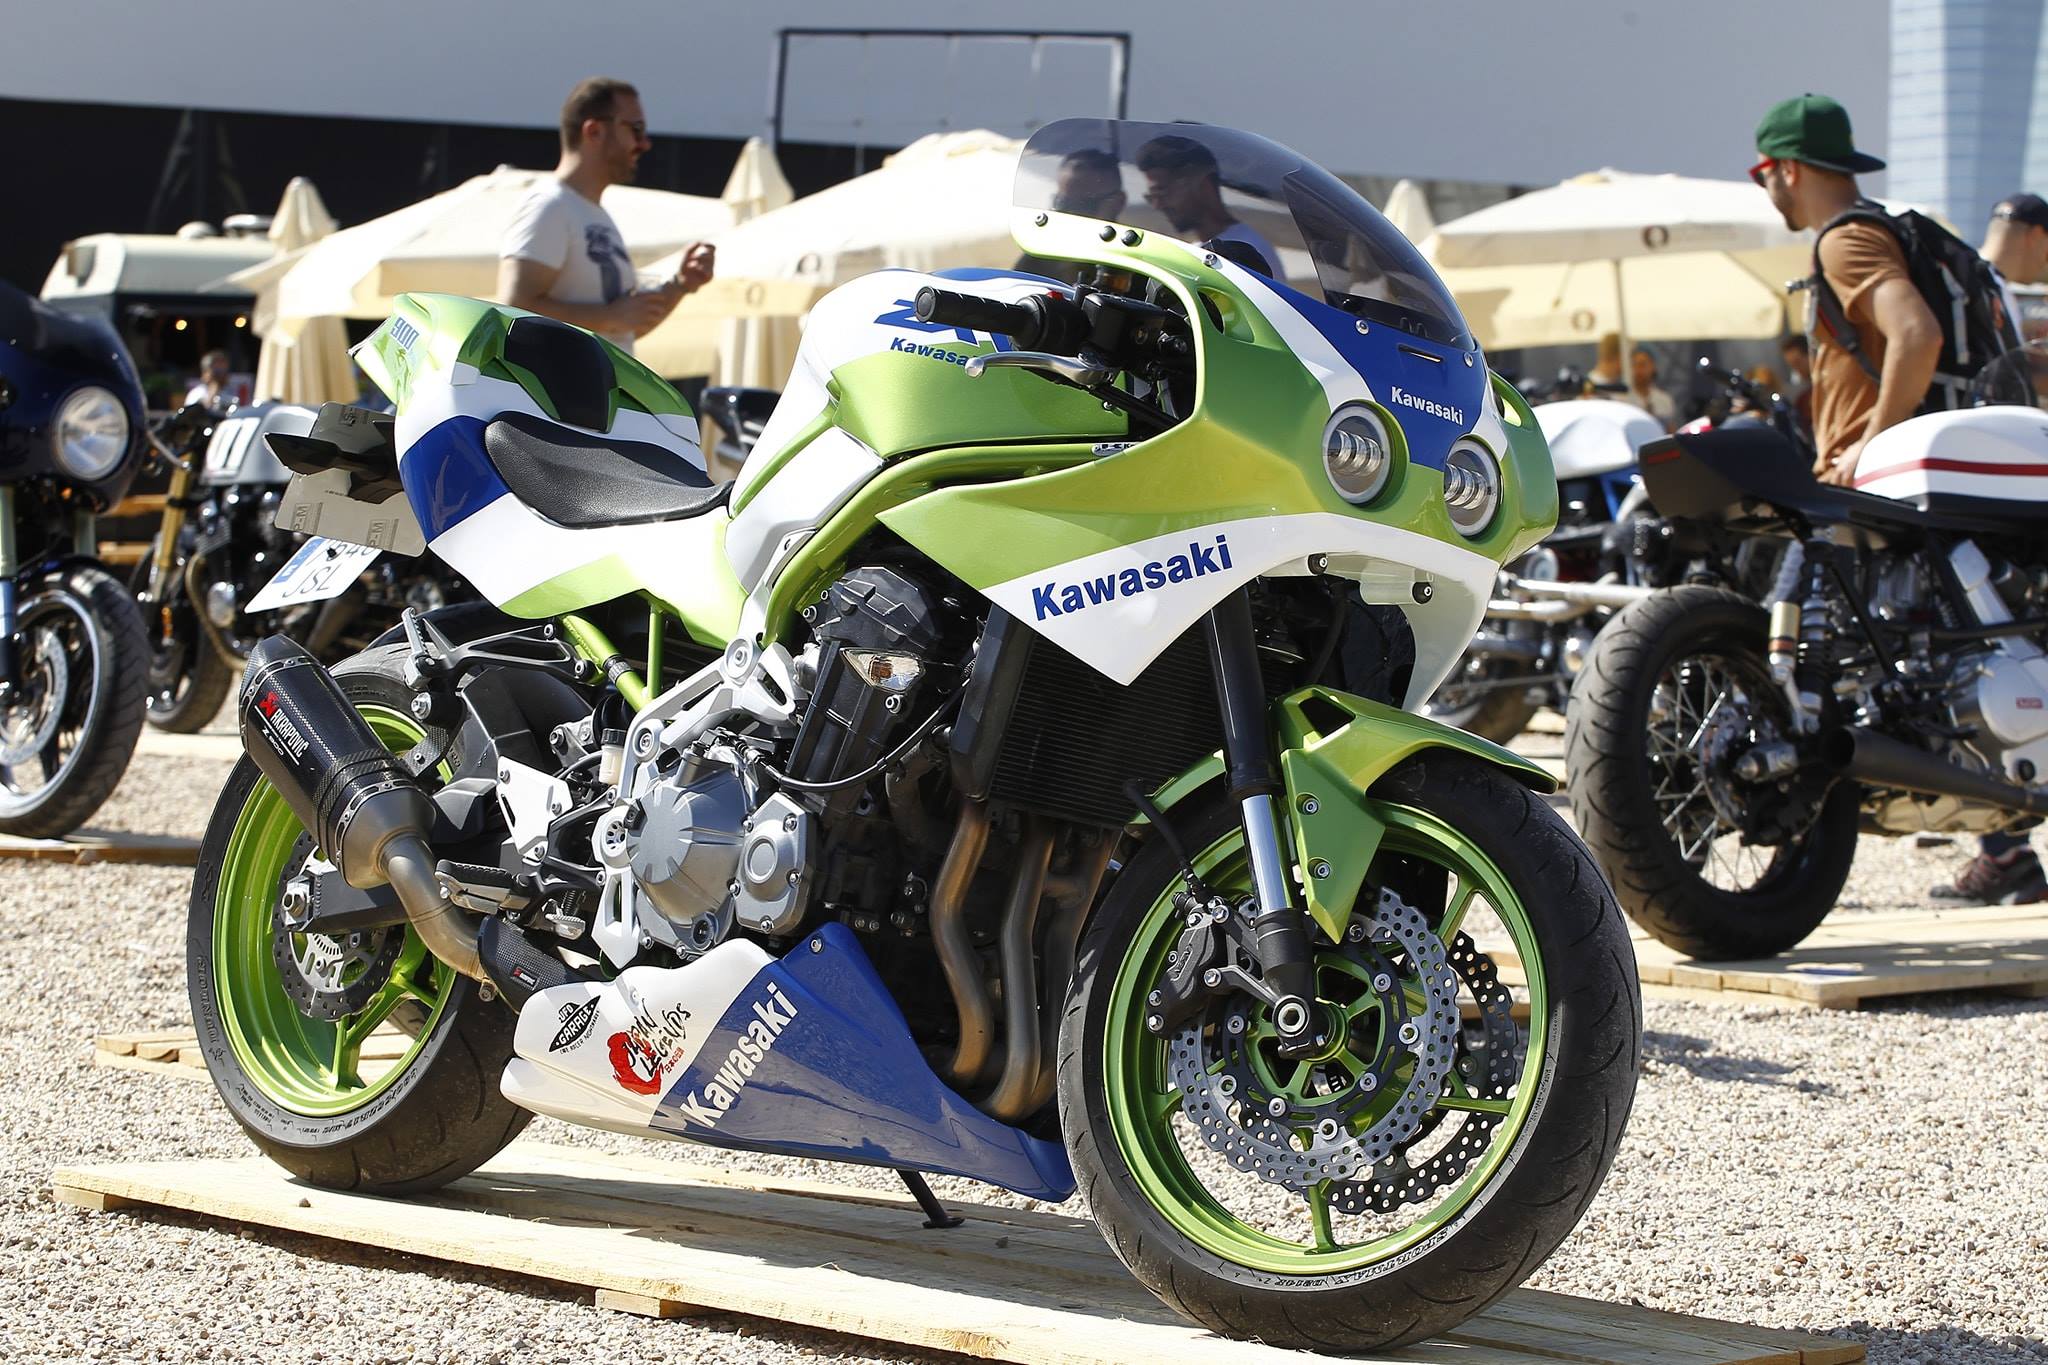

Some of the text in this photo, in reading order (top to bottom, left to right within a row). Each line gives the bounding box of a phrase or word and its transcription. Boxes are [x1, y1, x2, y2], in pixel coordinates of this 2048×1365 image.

[391, 317, 420, 350] 900
[890, 337, 979, 367] Kawasa
[1391, 386, 1463, 425] Kawasaki
[282, 563, 342, 598] JSL
[1032, 534, 1233, 621] Kawasaki
[559, 1006, 592, 1045] GARAGE
[560, 1004, 574, 1021] UFO
[680, 982, 798, 1128] Kawasaki
